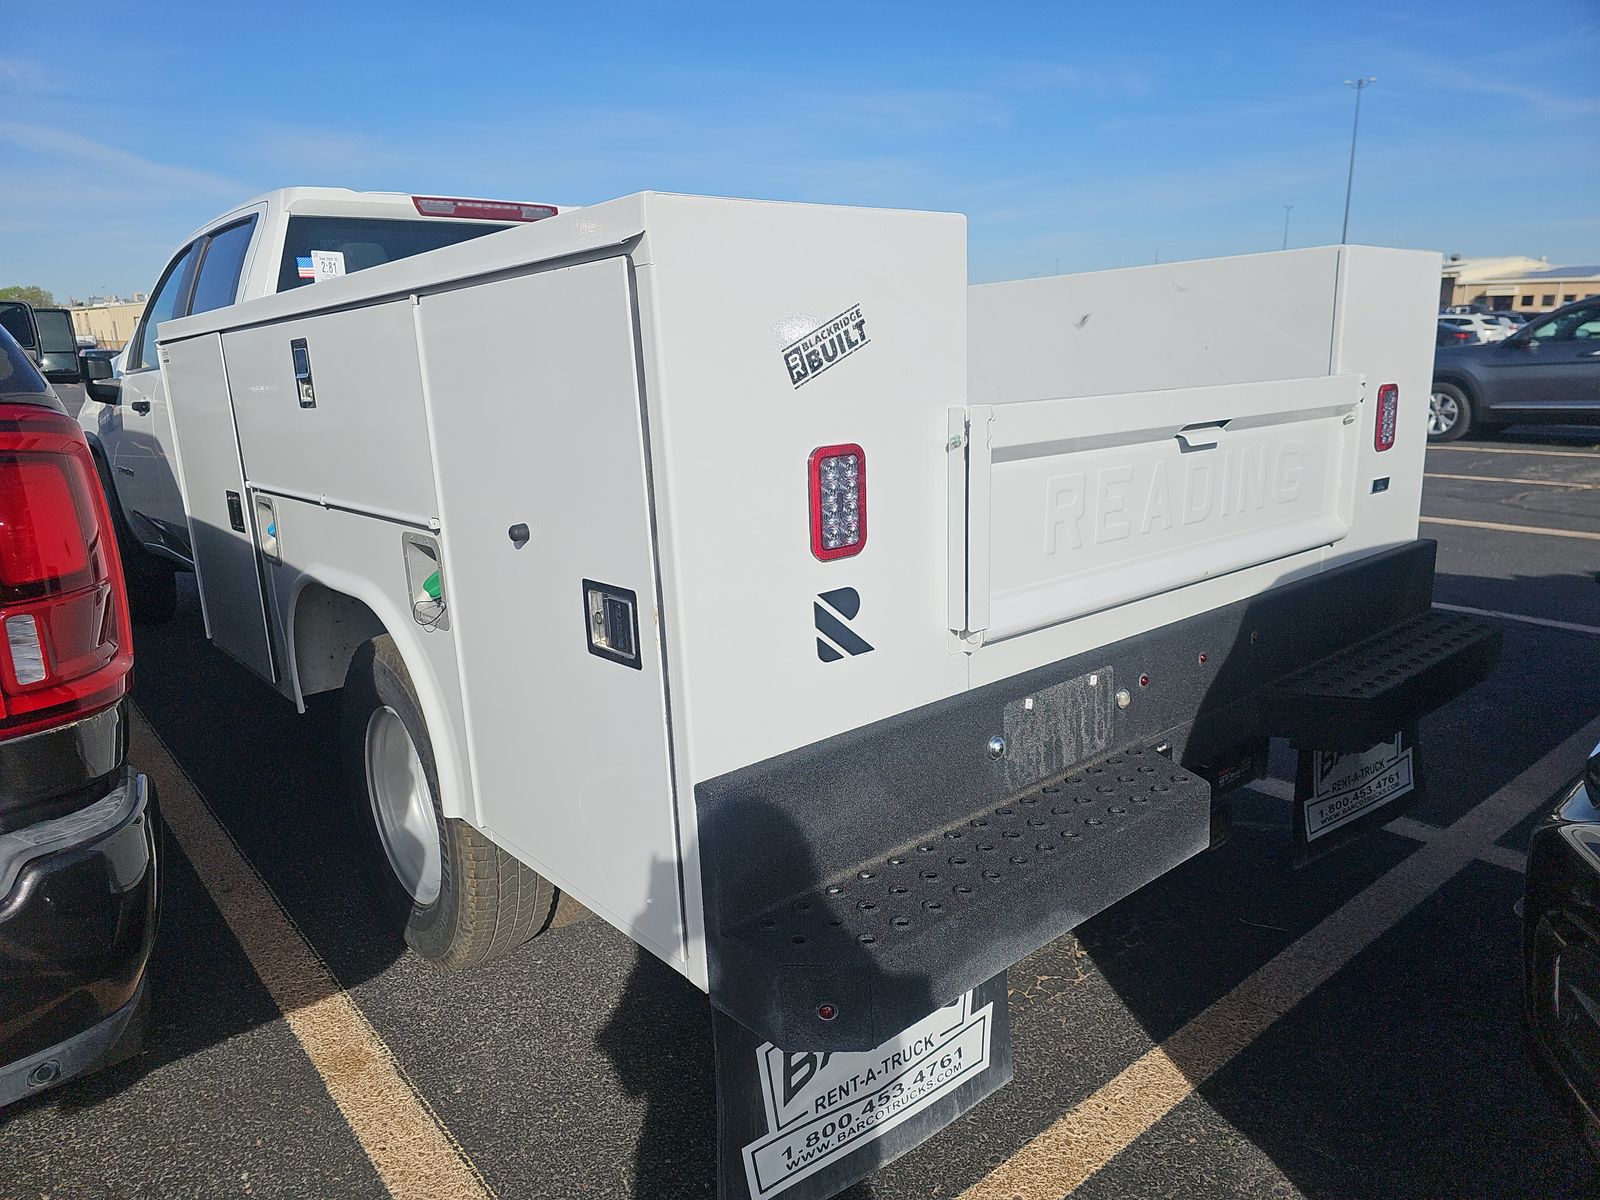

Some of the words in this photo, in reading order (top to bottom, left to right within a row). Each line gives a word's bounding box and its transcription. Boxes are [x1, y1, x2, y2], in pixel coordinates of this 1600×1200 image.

[802, 308, 862, 352] BLACKRIDGE
[805, 318, 867, 374] BUILT
[1045, 439, 1306, 556] READING
[1318, 771, 1400, 818] 1.800.453.4761
[1331, 758, 1386, 793] RENT-A-TRUCK
[780, 1046, 964, 1161] 1.800.453.4761
[814, 1032, 936, 1114] RENT-A-TRUCK
[784, 1061, 963, 1172] WWW.BARCOTRUCKS.COM
